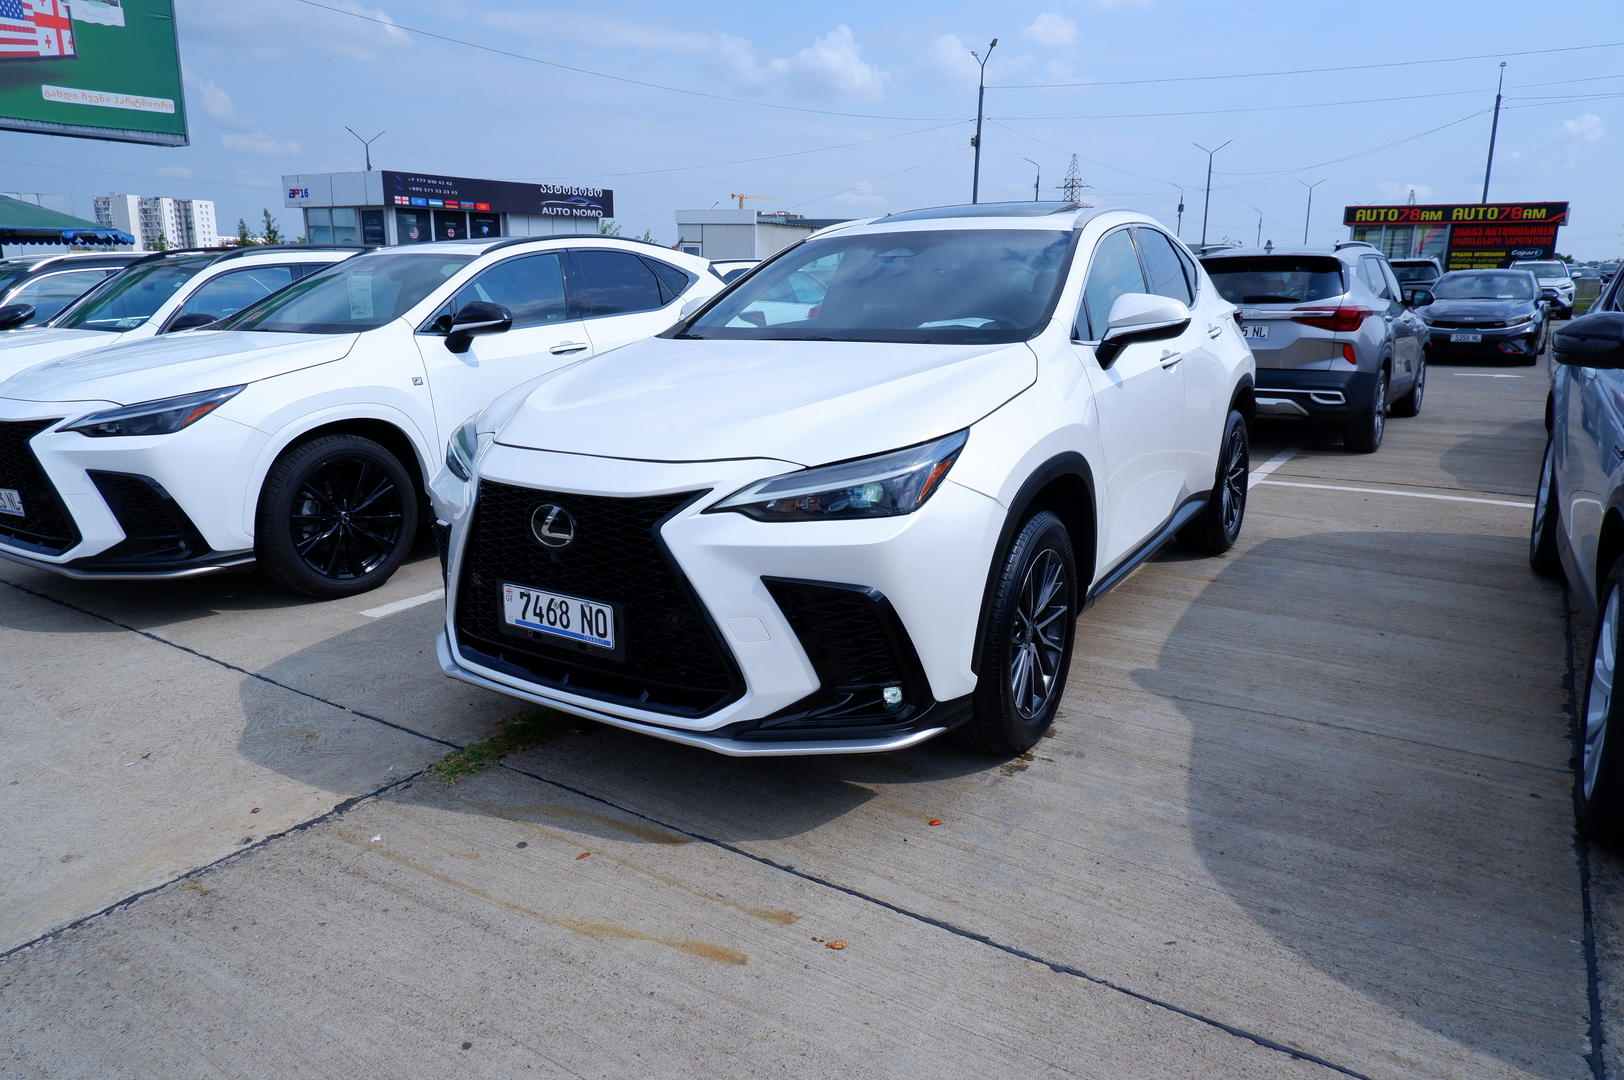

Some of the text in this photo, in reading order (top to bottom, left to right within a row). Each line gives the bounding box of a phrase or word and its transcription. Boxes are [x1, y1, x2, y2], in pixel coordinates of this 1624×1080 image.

[44, 89, 174, 110] გახდი ჩვენი პარტნიორი
[541, 206, 603, 218] AUTO NOMO
[1511, 249, 1539, 258] Copart
[1252, 326, 1266, 338] NL
[519, 591, 571, 630] 7468
